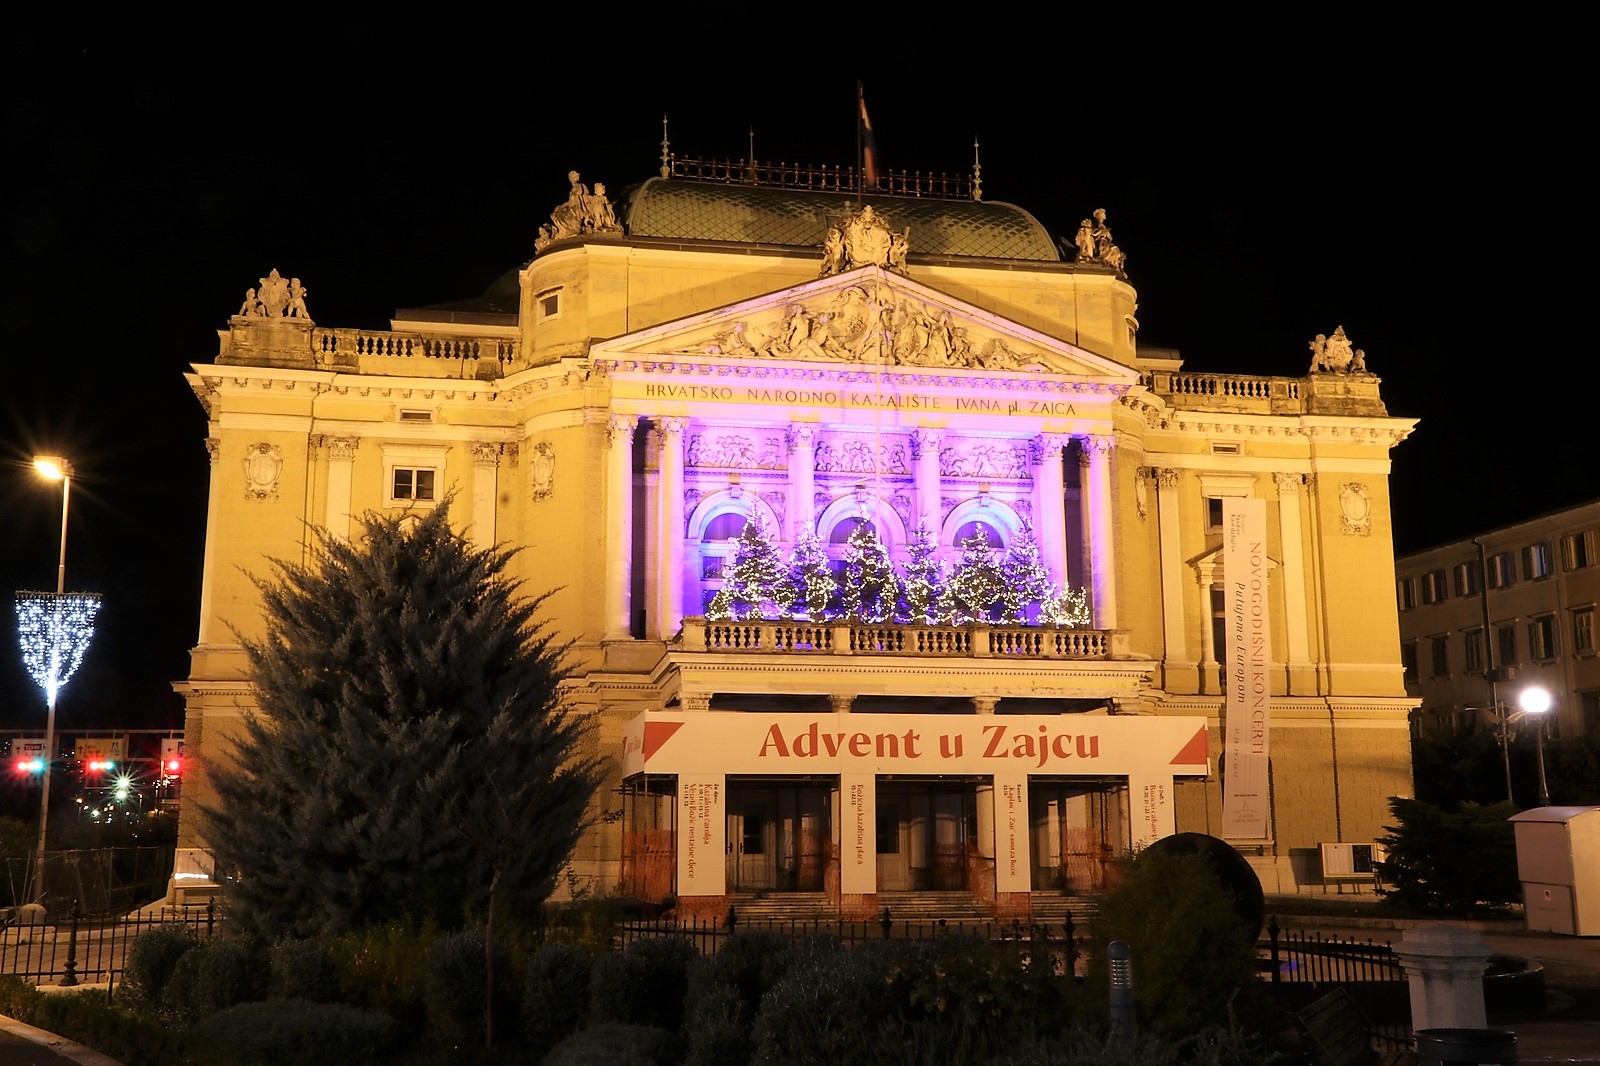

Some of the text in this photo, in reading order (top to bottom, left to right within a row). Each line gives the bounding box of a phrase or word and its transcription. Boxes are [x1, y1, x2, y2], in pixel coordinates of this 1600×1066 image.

[646, 384, 733, 400] HRVATSKO
[747, 388, 837, 405] NARODNO
[851, 393, 941, 409] KAZALIŠTE
[956, 398, 1001, 411] IVANA
[1008, 400, 1020, 416] pl.
[1233, 582, 1247, 703] Putujemo Europom
[1250, 542, 1265, 755] NOVOGODIŠNJI KONCERTI
[758, 721, 1100, 769] Advent u Zajcu
[688, 859, 696, 879] djece
